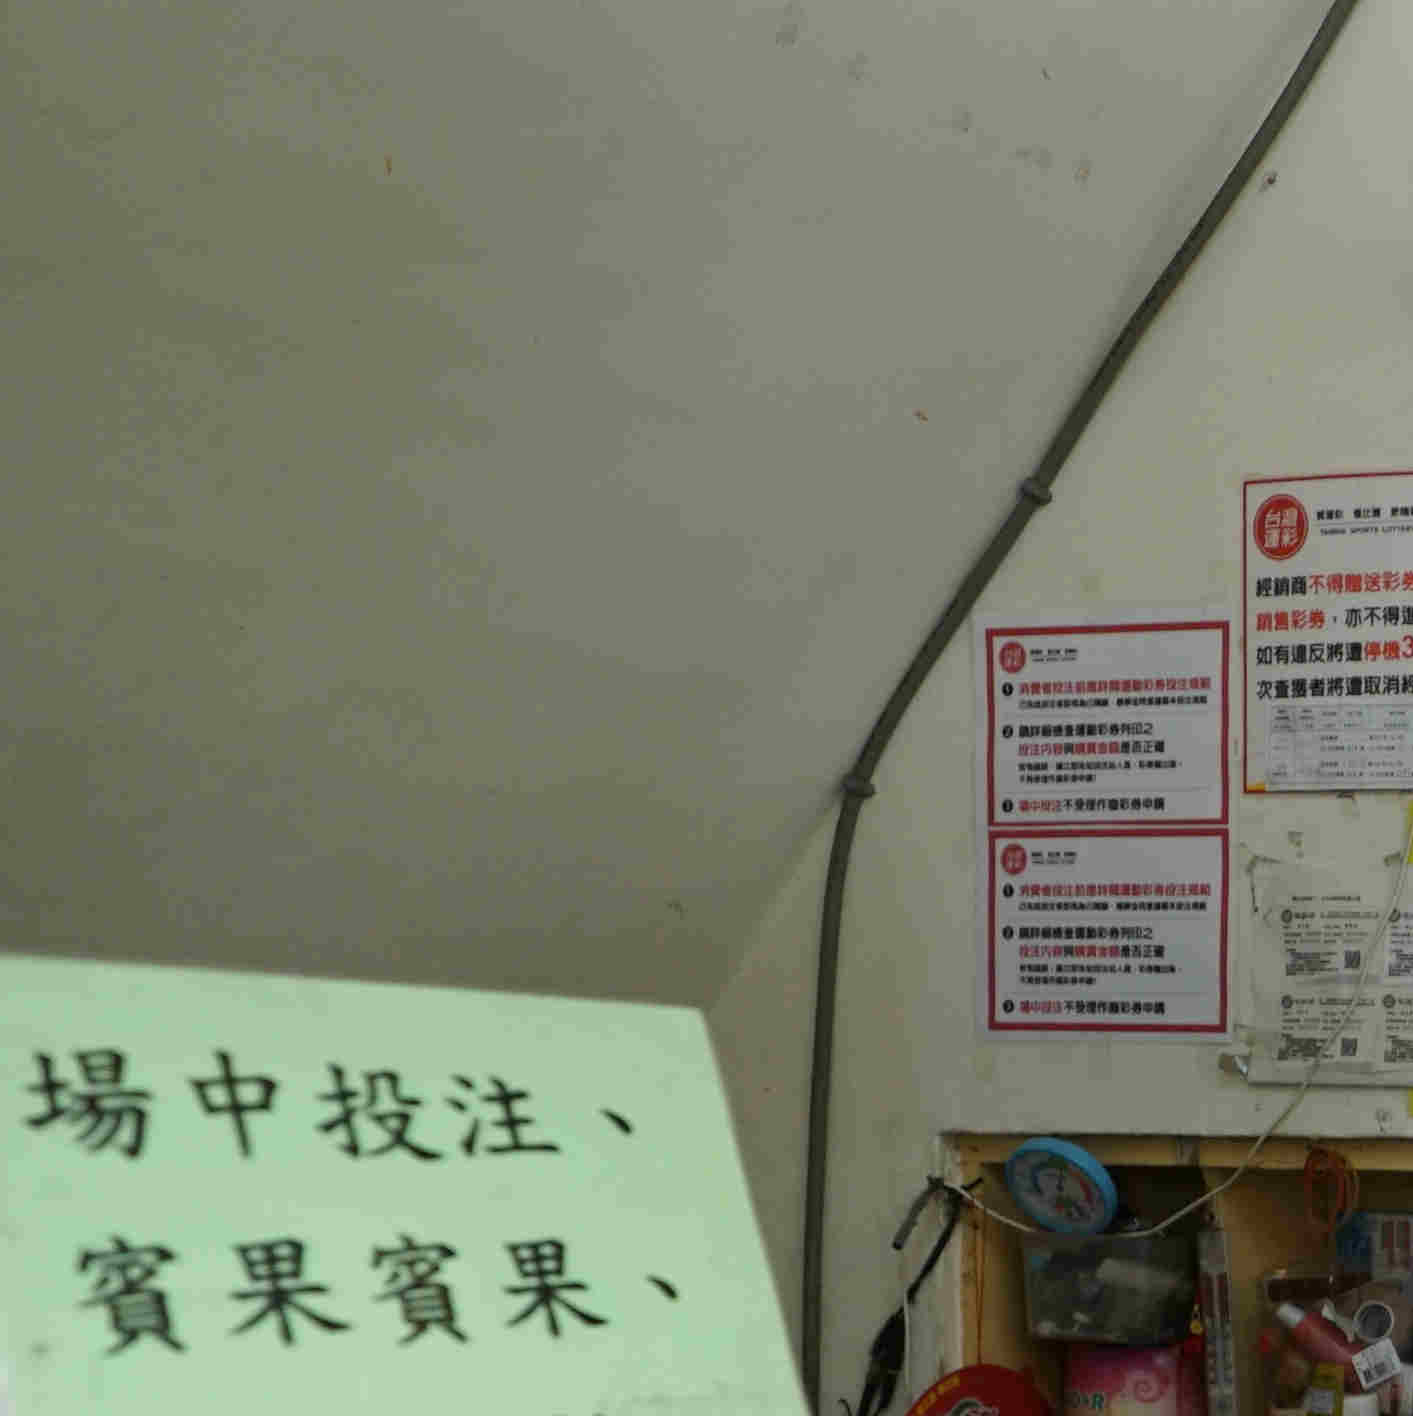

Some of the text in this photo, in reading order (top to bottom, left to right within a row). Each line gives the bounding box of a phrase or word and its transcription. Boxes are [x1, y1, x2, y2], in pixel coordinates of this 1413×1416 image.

[24, 1048, 635, 1162] 場中投注、
[73, 1236, 681, 1357] 賓果賓果、
